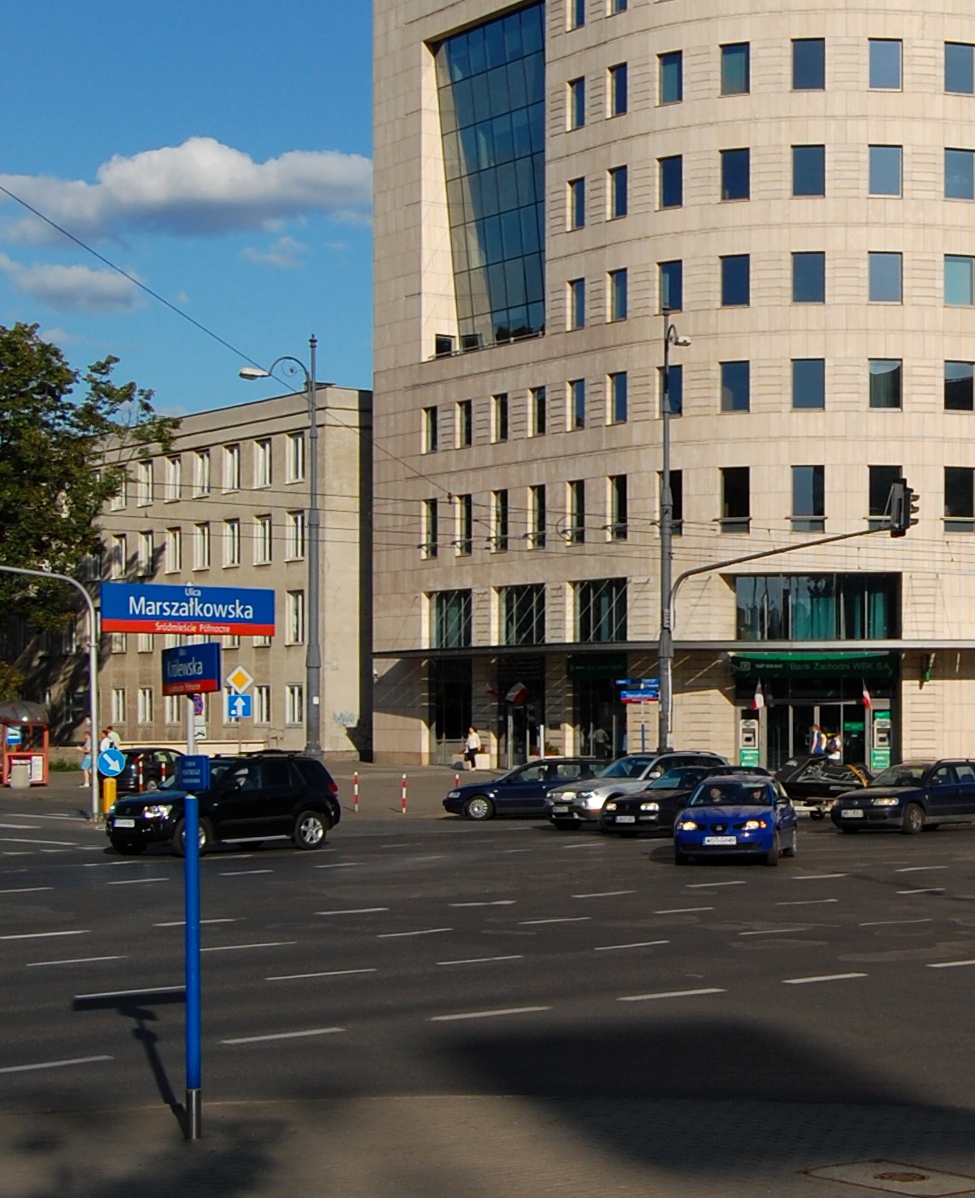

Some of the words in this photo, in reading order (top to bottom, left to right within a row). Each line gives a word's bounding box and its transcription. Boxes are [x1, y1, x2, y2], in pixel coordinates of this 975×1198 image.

[185, 587, 201, 596] Ulica
[129, 596, 253, 619] Marszałkowska
[155, 621, 197, 632] Śródmieście
[199, 623, 230, 633] Północne
[790, 661, 810, 670] Bank
[814, 662, 851, 670] Zachodni
[853, 661, 874, 670] WBK
